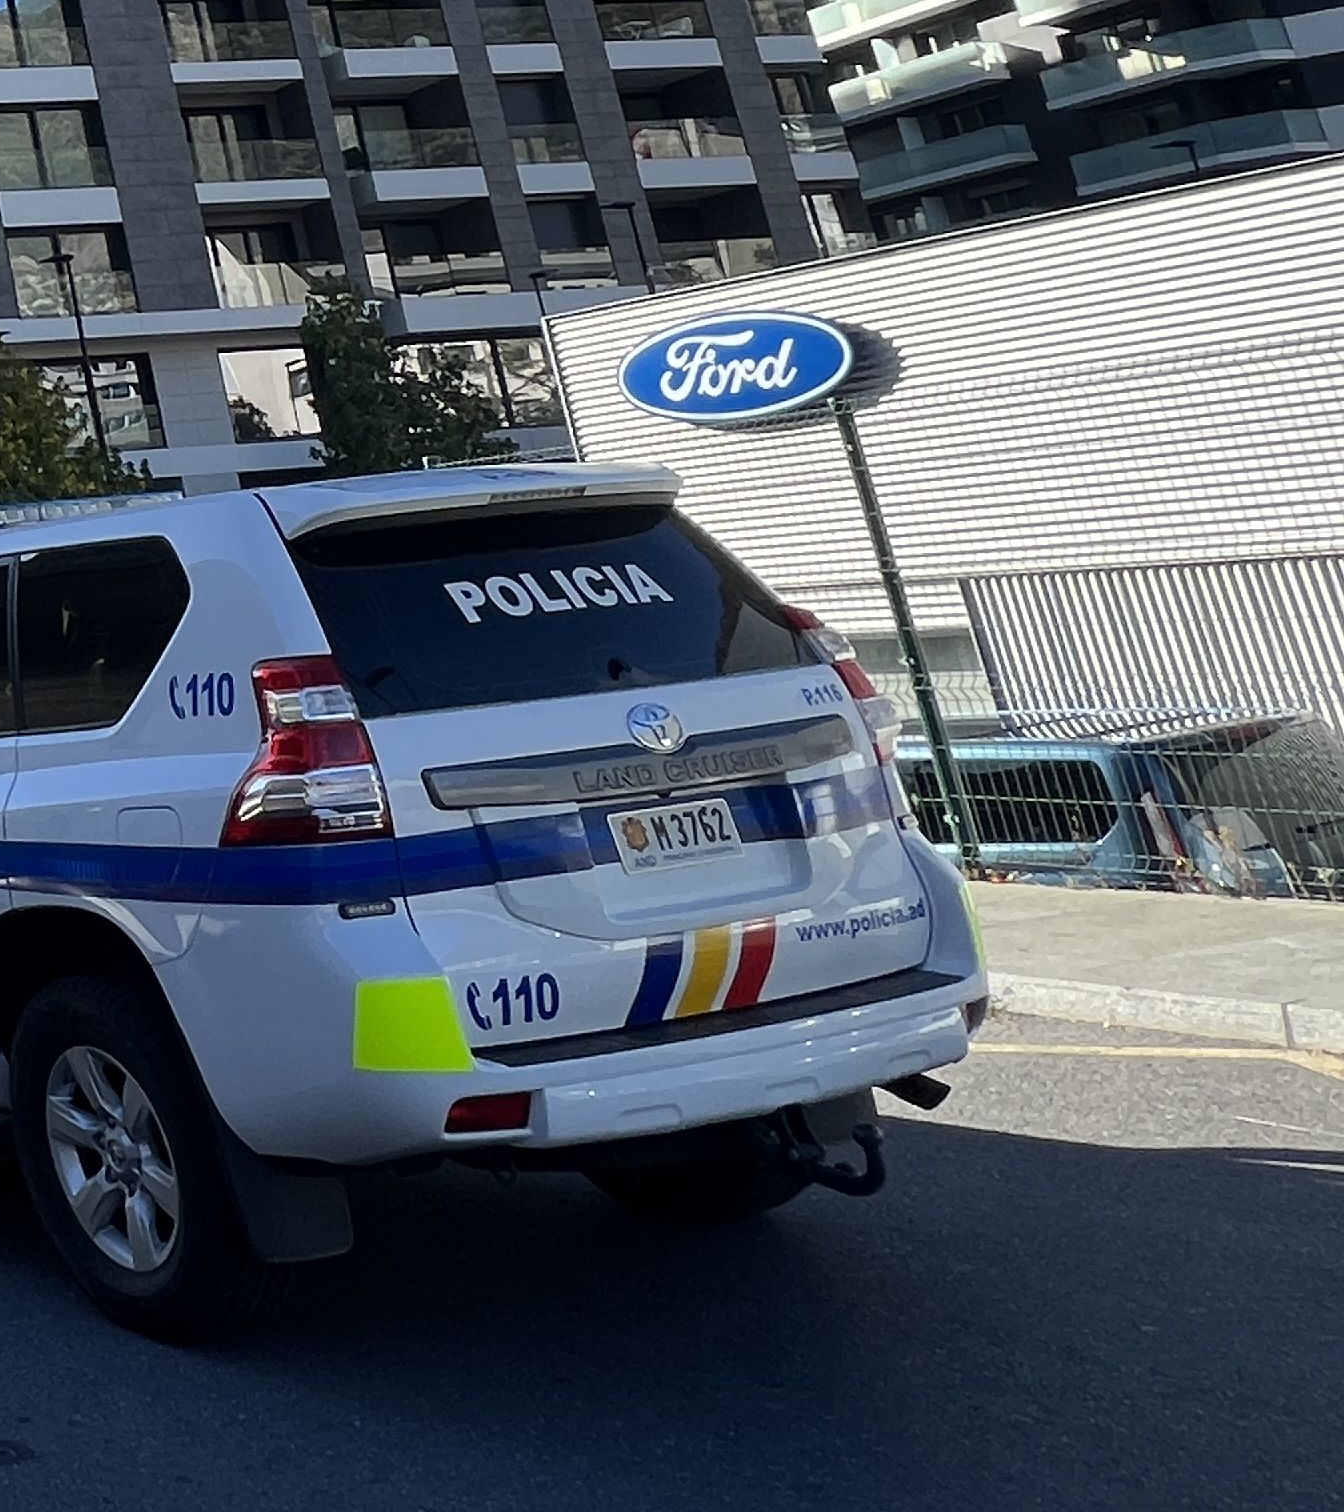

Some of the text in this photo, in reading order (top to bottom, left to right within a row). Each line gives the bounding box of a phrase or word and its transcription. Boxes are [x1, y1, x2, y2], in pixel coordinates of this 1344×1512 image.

[660, 329, 798, 402] Ford
[443, 563, 675, 624] POLICIA
[185, 671, 235, 717] 110
[572, 744, 784, 794] LAND CRUISER
[796, 898, 925, 942] www.policia.ad
[492, 972, 560, 1026] 110
